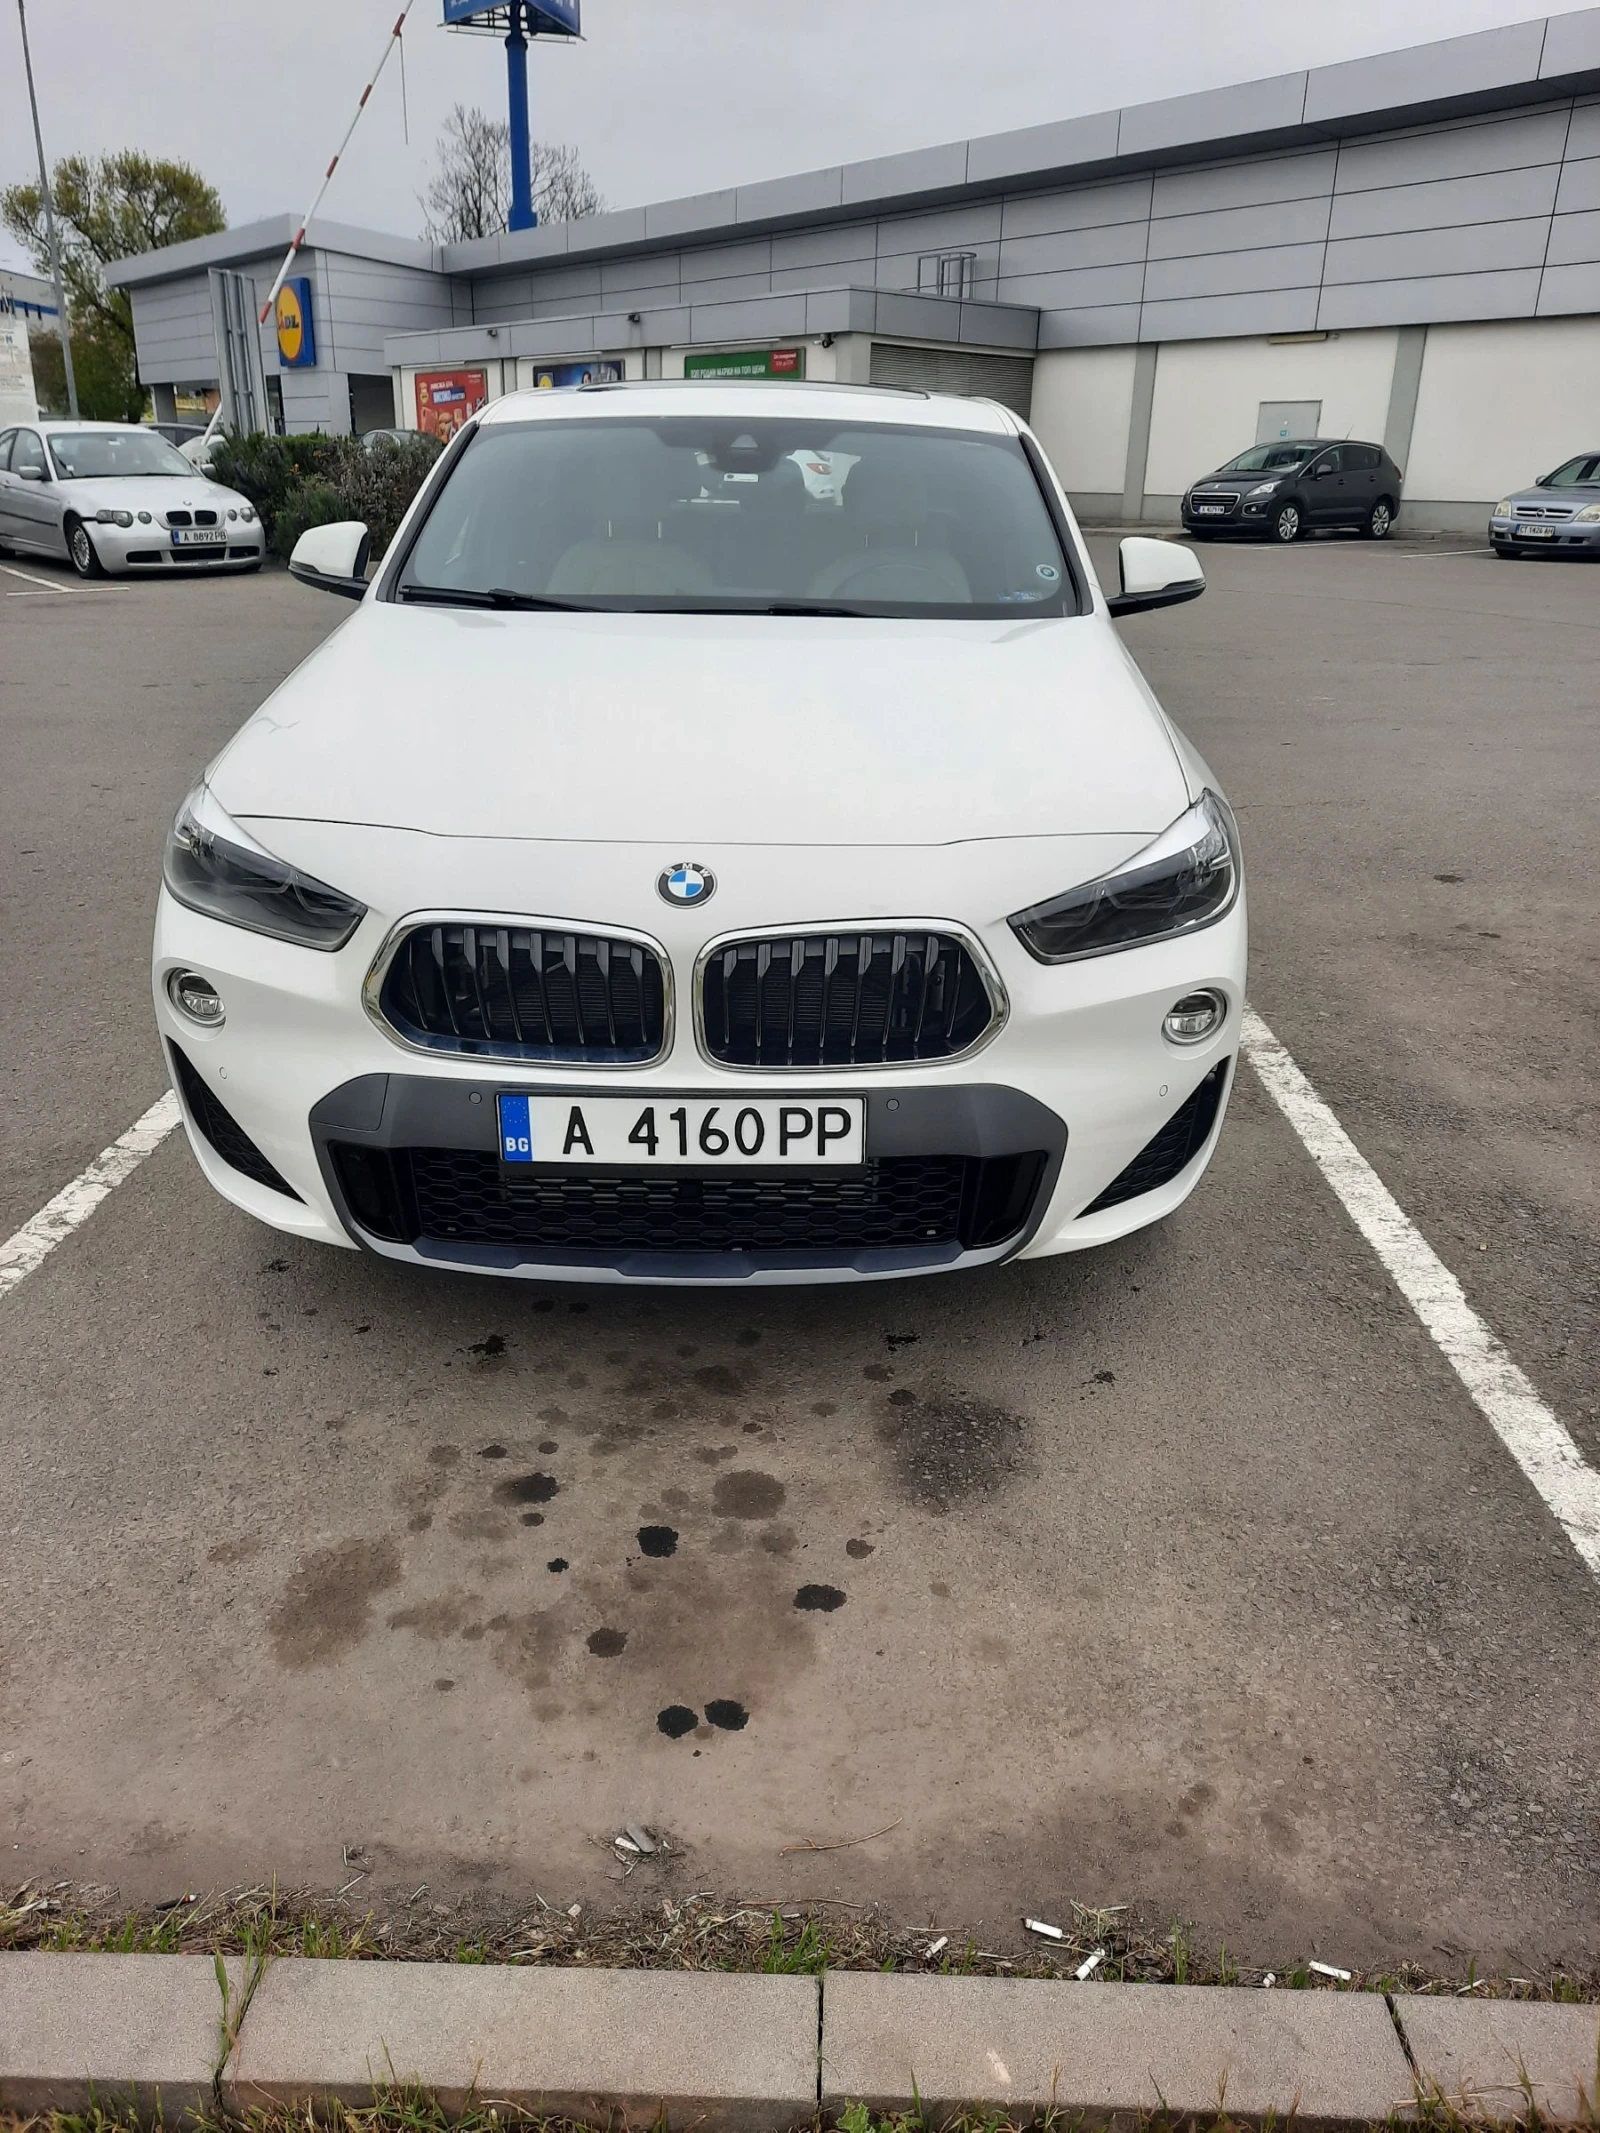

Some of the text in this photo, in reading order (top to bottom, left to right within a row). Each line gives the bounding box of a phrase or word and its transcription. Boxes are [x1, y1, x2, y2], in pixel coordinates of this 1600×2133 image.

[184, 532, 189, 541] A
[664, 863, 711, 878] BMW
[562, 1106, 851, 1156] A 4160 PP
[505, 1137, 529, 1152] BG
